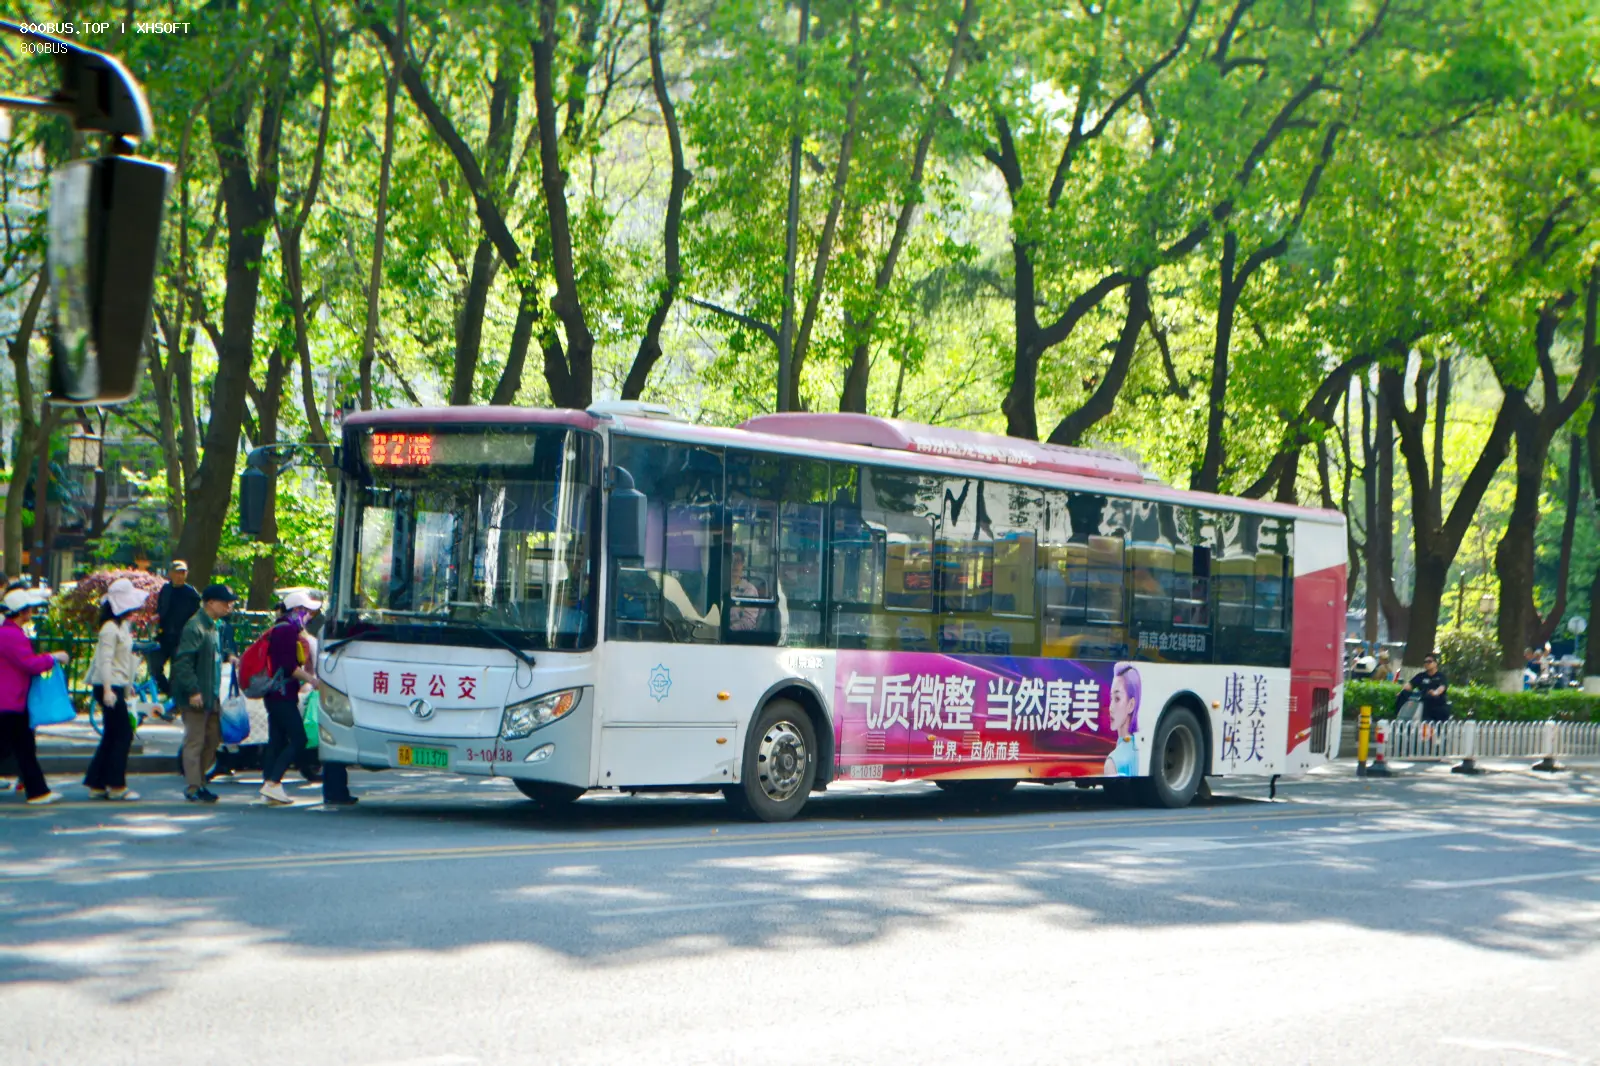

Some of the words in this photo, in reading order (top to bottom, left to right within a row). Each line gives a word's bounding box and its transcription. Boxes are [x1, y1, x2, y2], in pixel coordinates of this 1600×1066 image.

[373, 670, 477, 700] 南京公交
[1223, 672, 1267, 717] 康美
[844, 671, 976, 731] 气质微整
[985, 676, 1100, 731] 当然康美
[466, 748, 513, 762] 3-10138
[851, 765, 882, 778] 3-10138
